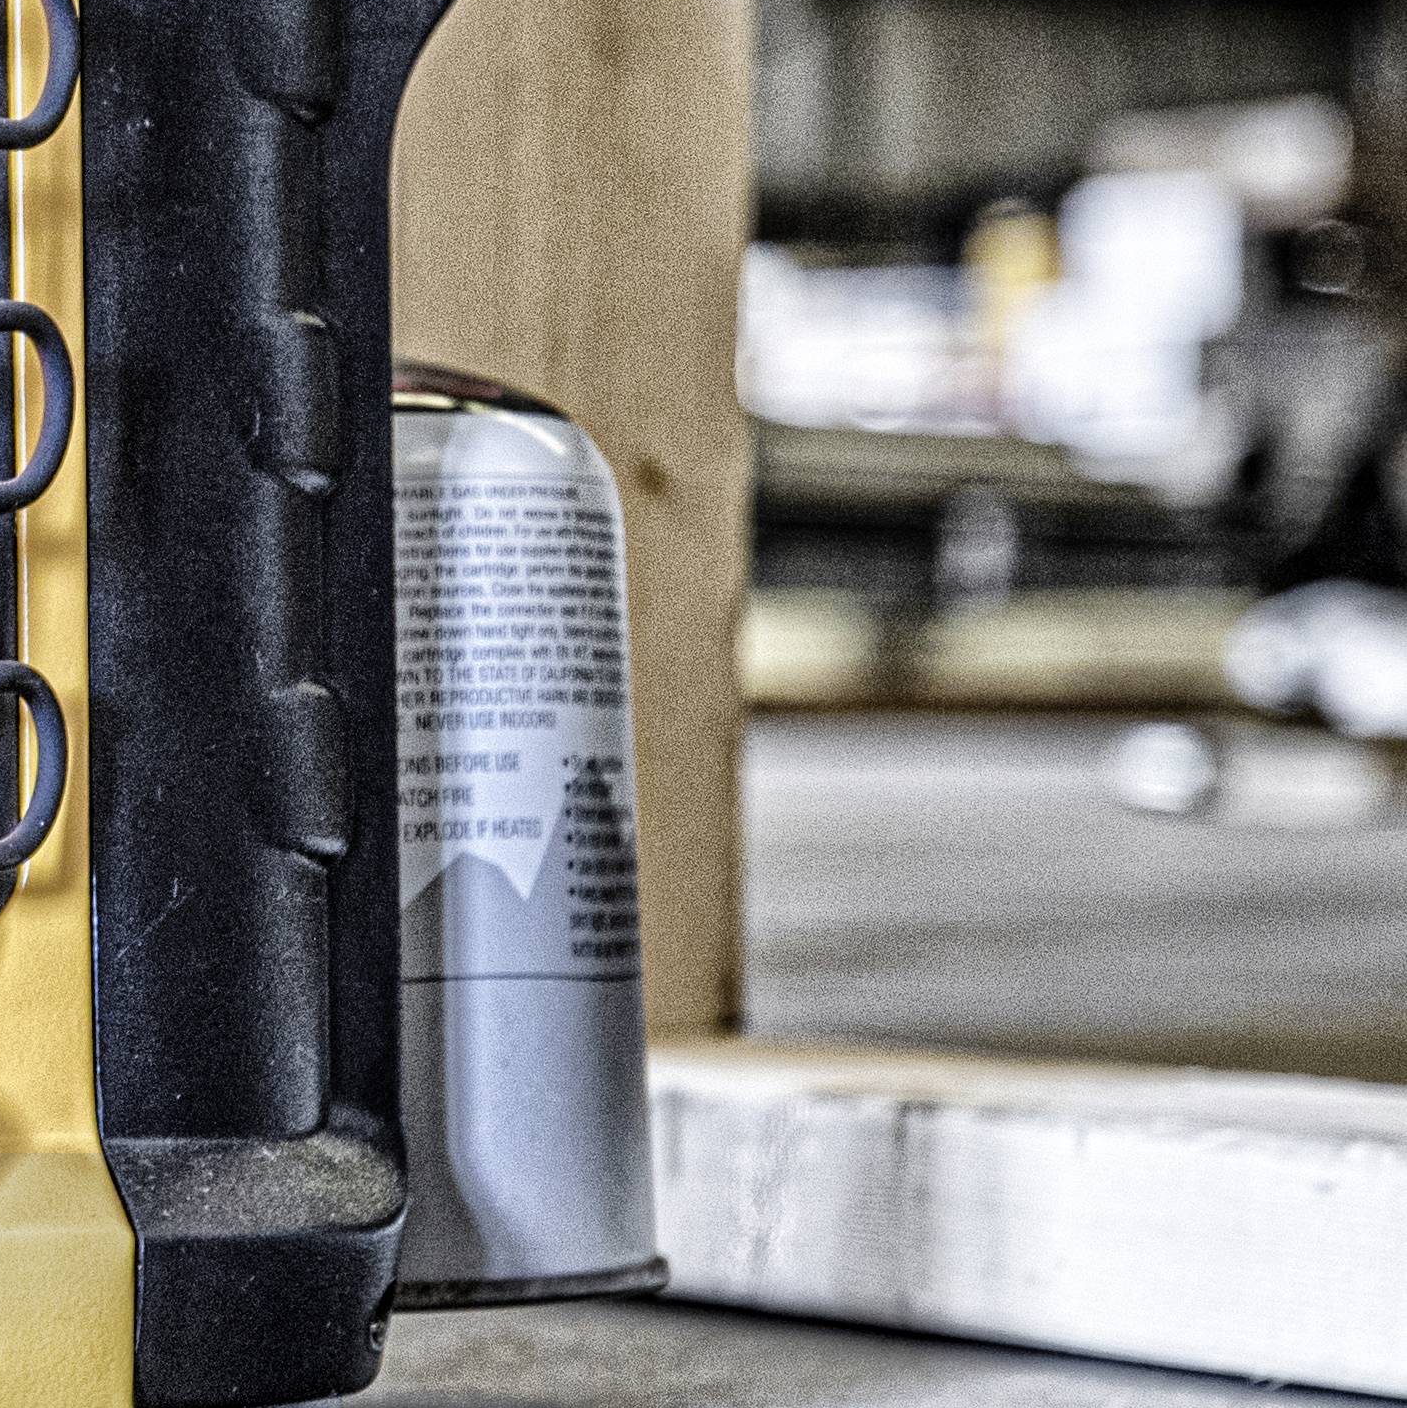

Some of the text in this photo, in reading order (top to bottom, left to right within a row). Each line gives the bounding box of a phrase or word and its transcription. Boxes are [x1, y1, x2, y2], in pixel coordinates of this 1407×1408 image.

[449, 665, 473, 683] THE
[478, 665, 519, 682] STATE
[521, 665, 536, 681] OF
[415, 710, 464, 732] NEVER
[469, 710, 495, 730] USE
[434, 751, 491, 774] BEFORE
[494, 750, 521, 772] USE
[442, 785, 473, 806] FIRE
[403, 818, 470, 842] EXPLODE
[476, 817, 487, 840] IF
[492, 816, 543, 840] HEATED
